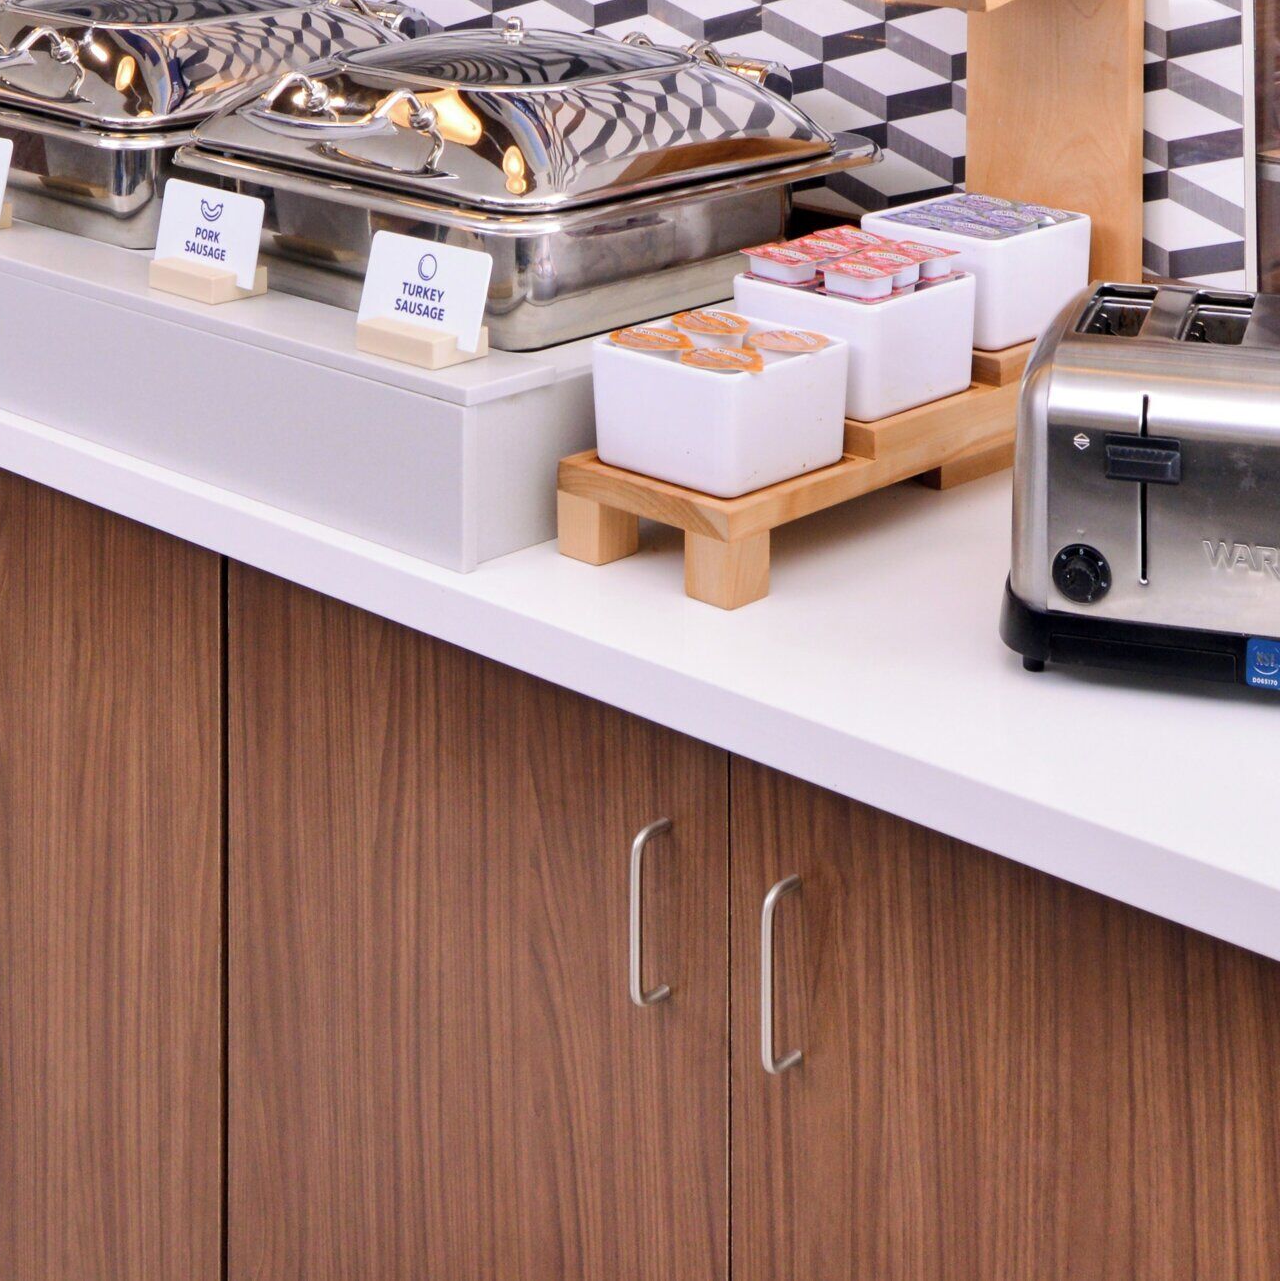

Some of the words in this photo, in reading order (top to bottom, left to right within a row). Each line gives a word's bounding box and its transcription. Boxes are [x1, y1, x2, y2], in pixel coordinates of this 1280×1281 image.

[195, 227, 220, 243] PORK
[185, 240, 226, 261] SAUSAGE
[402, 282, 445, 303] TURKEY
[394, 298, 445, 321] SAUSAGE
